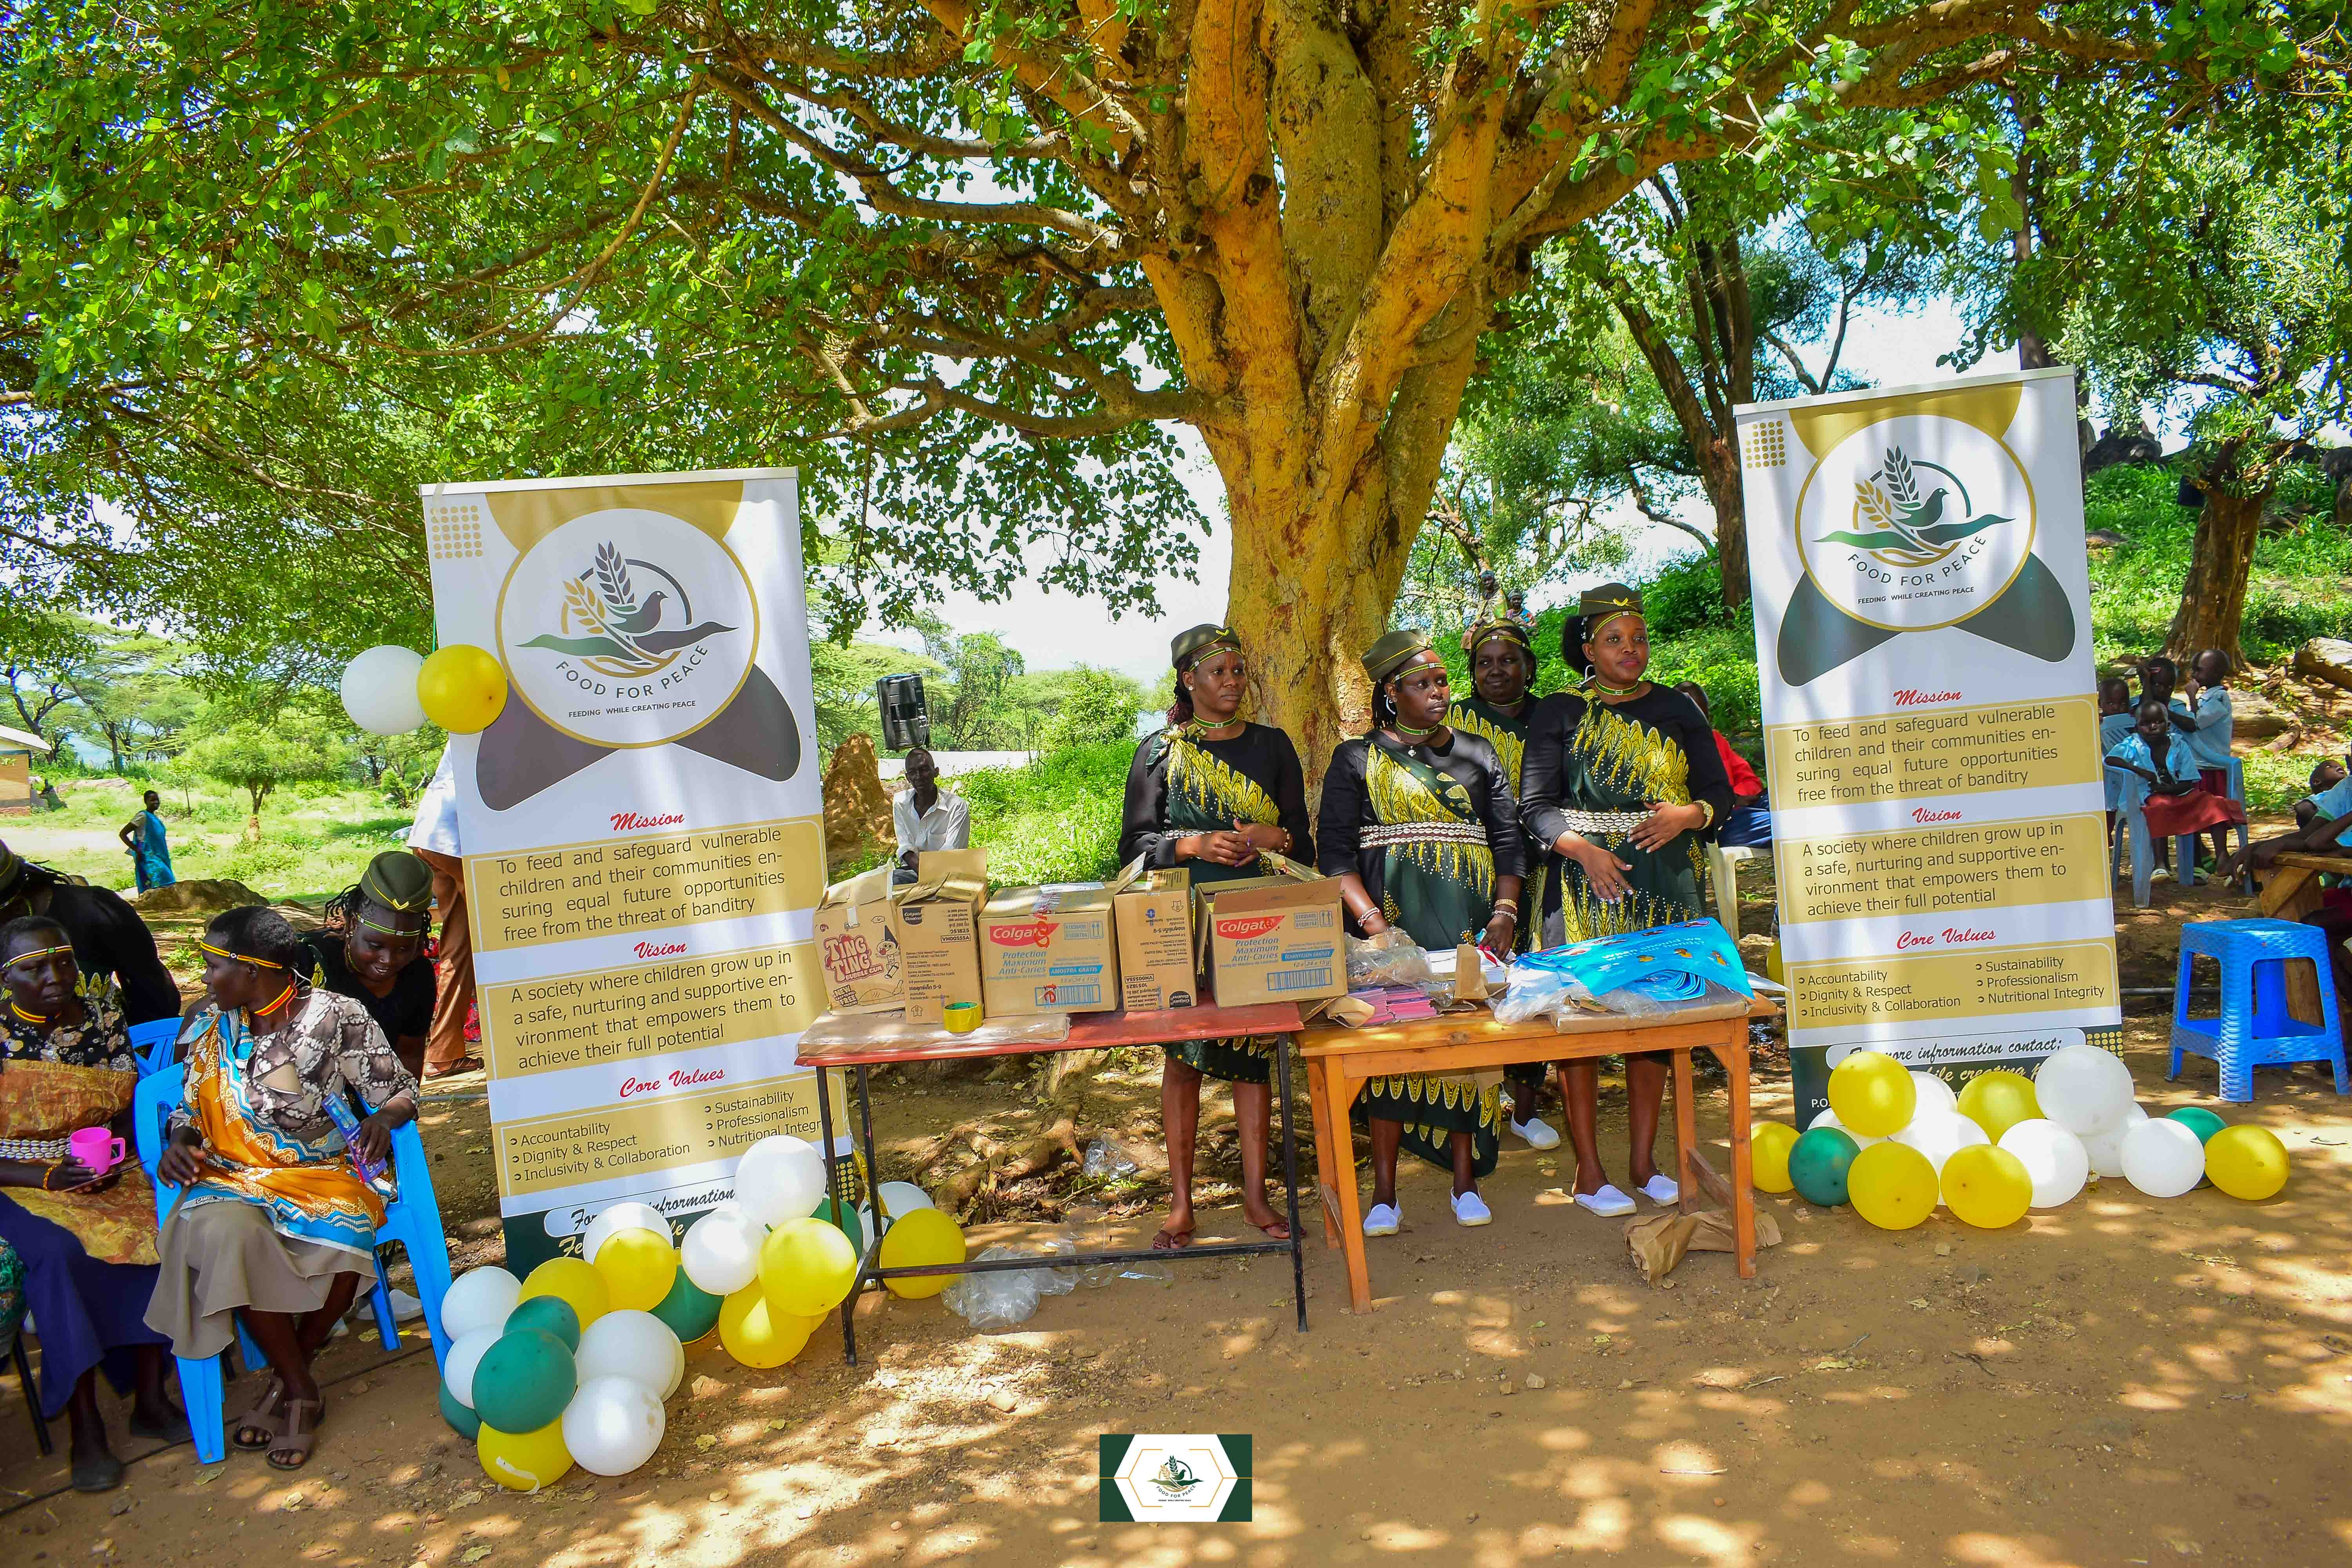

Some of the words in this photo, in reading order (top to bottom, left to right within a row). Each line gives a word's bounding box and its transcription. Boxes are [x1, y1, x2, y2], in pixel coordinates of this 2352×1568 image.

[1847, 554, 1891, 583] FOOD
[1900, 573, 1935, 586] FOR
[1942, 536, 1986, 577] PEACE
[1858, 596, 1886, 604] FEEDING
[1915, 589, 1950, 598] CREATING
[1952, 586, 1975, 595] PEACE
[555, 661, 606, 695] FOOD
[616, 685, 654, 699] FOR
[660, 643, 708, 690] PEACE
[568, 709, 601, 718] FEEDING
[605, 706, 630, 715] WHILE
[632, 702, 670, 712] CREATING
[672, 700, 696, 708] PEACE
[1894, 690, 1961, 706] Mission
[1792, 729, 1809, 742] To
[1818, 724, 1850, 740] feed
[1860, 720, 1886, 736] and
[1896, 712, 1968, 733] safeguard
[1978, 705, 2055, 725] vulnerable
[1795, 746, 1851, 762] children
[1858, 740, 1885, 756] and
[1891, 738, 1925, 753] their
[1931, 729, 2025, 749] communities
[1797, 767, 1840, 782] suring
[1853, 760, 1892, 779] equal
[1904, 758, 1948, 772] future
[1960, 746, 2058, 769] opportunities
[1797, 788, 1826, 802] free
[1830, 785, 1865, 799] from
[1870, 781, 1894, 795] the
[1898, 777, 1944, 793] threat
[1967, 769, 2028, 786] banditry
[610, 812, 684, 831] Mission
[1913, 807, 1961, 823] Vision
[1817, 840, 1866, 855] society
[1871, 836, 1916, 851] where
[1921, 831, 1979, 846] children
[1984, 828, 2021, 844] grow
[2027, 826, 2045, 840] up
[2050, 822, 2063, 835] in
[496, 859, 517, 874] To
[526, 852, 563, 871] feed
[573, 847, 603, 866] and
[613, 837, 691, 860] safeguard
[701, 828, 781, 849] vulnerable
[1817, 860, 1851, 876] safe,
[1856, 855, 1922, 872] nurturing
[1927, 850, 1954, 866] and
[1959, 846, 2036, 865] supportive
[500, 878, 564, 897] children
[572, 869, 602, 888] and
[608, 866, 646, 883] their
[653, 854, 751, 878] communities
[1805, 878, 1880, 896] vironment
[1886, 875, 1916, 890] that
[1922, 870, 1998, 888] empowers
[2005, 865, 2043, 880] them
[2051, 863, 2066, 876] to
[502, 901, 552, 919] suring
[566, 891, 610, 913] equal
[623, 887, 671, 904] future
[684, 871, 785, 900] opportunities
[1808, 900, 1862, 916] achieve
[1866, 896, 1900, 911] their
[1904, 893, 1926, 908] full
[1932, 887, 1996, 912] potential
[504, 926, 537, 941] free
[542, 921, 581, 936] from
[586, 915, 613, 931] the
[617, 907, 667, 926] threat
[692, 897, 755, 922] banditry
[634, 942, 686, 959] Vision
[824, 936, 866, 960] TING
[1236, 938, 1278, 947] Protection
[1236, 946, 1278, 954] Maximum
[1896, 932, 1934, 949] Core
[1942, 928, 1995, 943] Values
[1003, 951, 1046, 959] Protection
[1232, 953, 1278, 962] Anti-Caries
[1986, 956, 2064, 974] Sustainability
[528, 980, 584, 1002] society
[589, 975, 639, 991] where
[644, 964, 705, 984] children
[711, 958, 749, 980] grow
[754, 955, 773, 970] up
[778, 951, 791, 964] in
[831, 954, 871, 981] TING
[999, 967, 1046, 975] Anti-Caries
[1808, 970, 1887, 986] Accountability
[834, 985, 850, 996] NEW
[1987, 972, 2078, 988] Professionalism
[528, 1005, 567, 1023] safe,
[573, 995, 646, 1016] nurturing
[651, 986, 679, 1005] and
[684, 977, 764, 1001] supportive
[839, 995, 857, 1005] FREE
[1809, 989, 1849, 1003] Dignity
[1866, 984, 1913, 998] Respect
[1988, 988, 2049, 1004] Nutritional
[2054, 985, 2105, 1000] Integrity
[1809, 1003, 1867, 1017] Inclusivity
[1885, 996, 1960, 1011] Collaboration
[515, 1022, 599, 1047] vironment
[606, 1016, 639, 1033] that
[646, 1005, 726, 1028] empowers
[733, 998, 772, 1014] them
[779, 993, 795, 1006] to
[519, 1049, 580, 1071] achieve
[585, 1040, 622, 1058] their
[627, 1034, 651, 1052] full
[657, 1023, 724, 1051] potential
[1917, 1042, 2003, 1064] infrormation
[620, 1077, 661, 1098] Core
[668, 1069, 726, 1090] Values
[715, 1090, 794, 1114] Sustainability
[717, 1103, 809, 1131] Professionalism
[521, 1122, 610, 1147] Accountability
[718, 1127, 780, 1148] Nutritional
[523, 1147, 568, 1165] Dignity
[587, 1134, 638, 1153] Respect
[524, 1161, 589, 1181] Inclusivity
[608, 1142, 690, 1167] Collaboration
